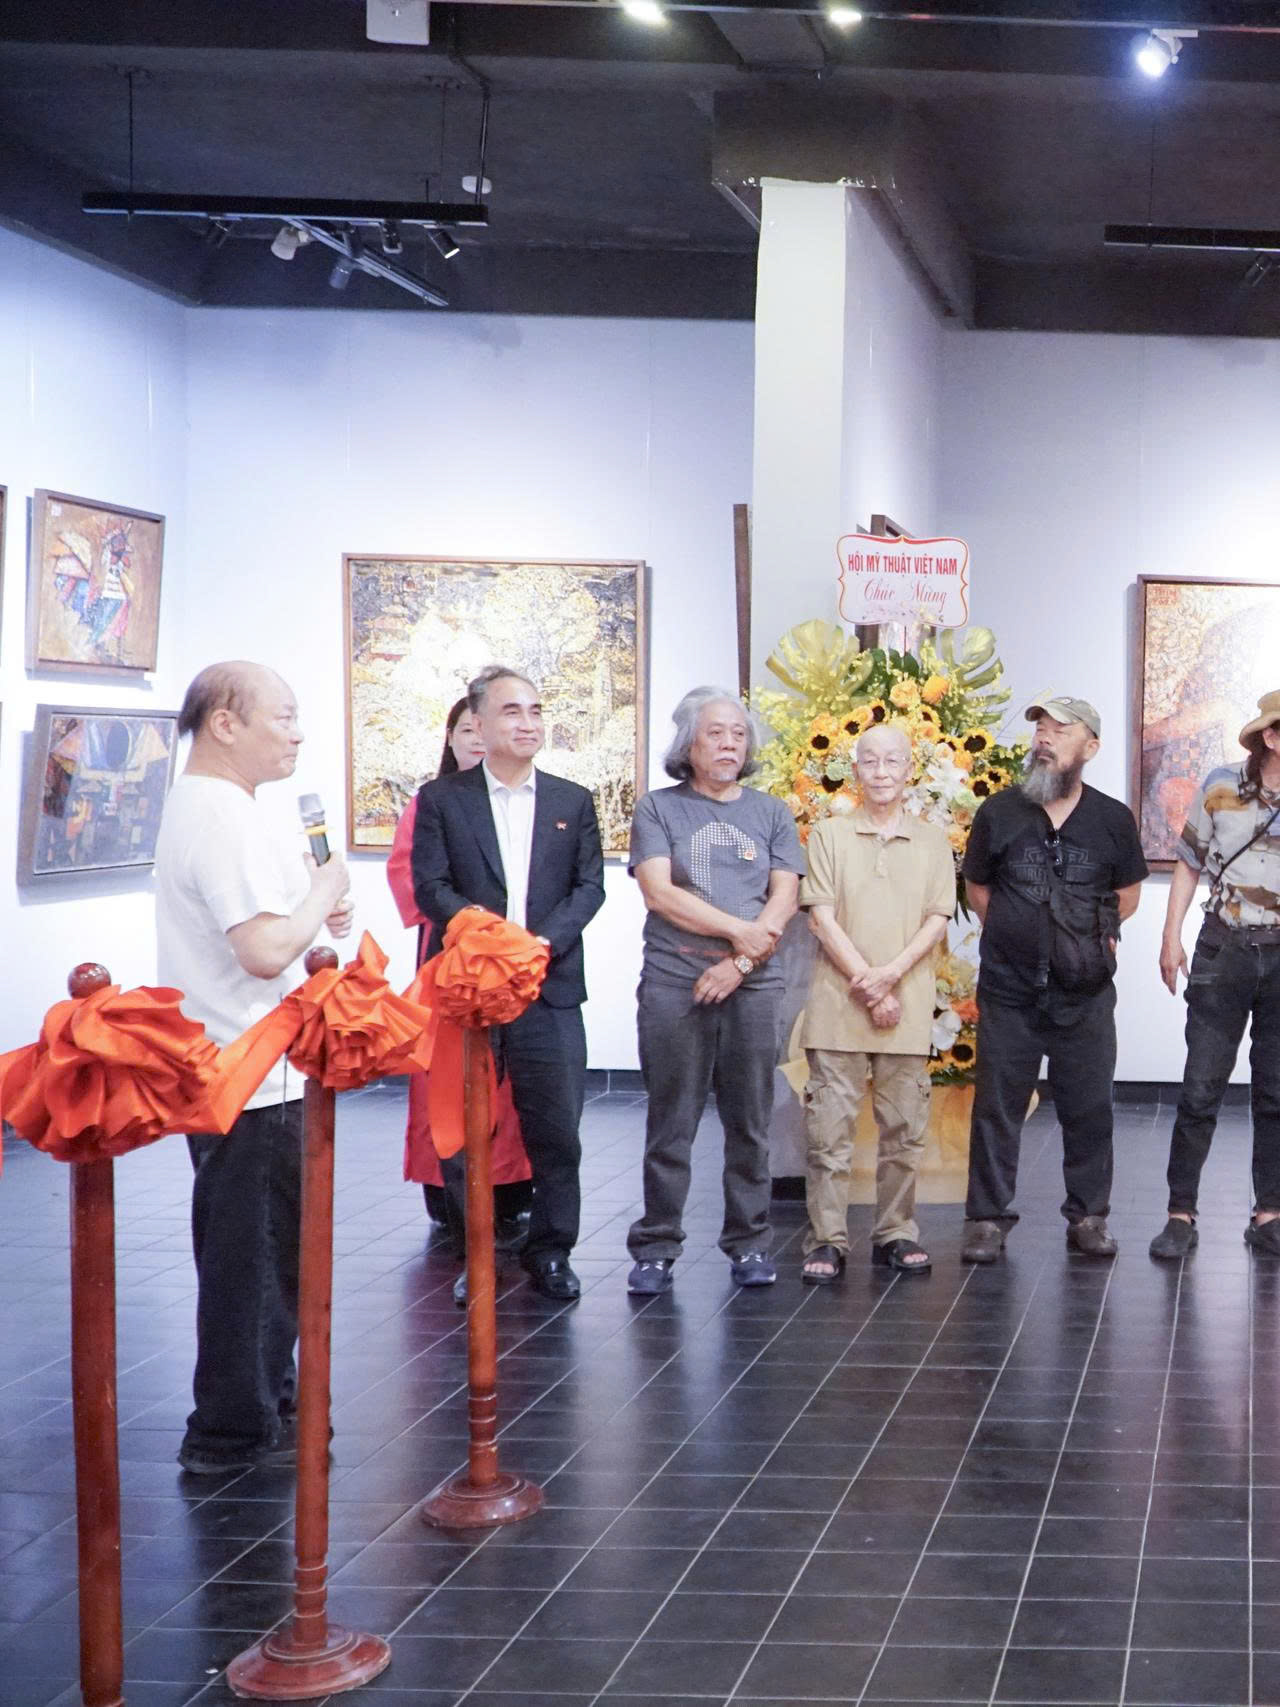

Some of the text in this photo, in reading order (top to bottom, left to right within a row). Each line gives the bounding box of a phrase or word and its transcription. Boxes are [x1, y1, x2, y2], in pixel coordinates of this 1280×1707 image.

[848, 550, 958, 578] HỘI MỸ THUẬT VIỆT NAM
[863, 577, 896, 602] Chúc
